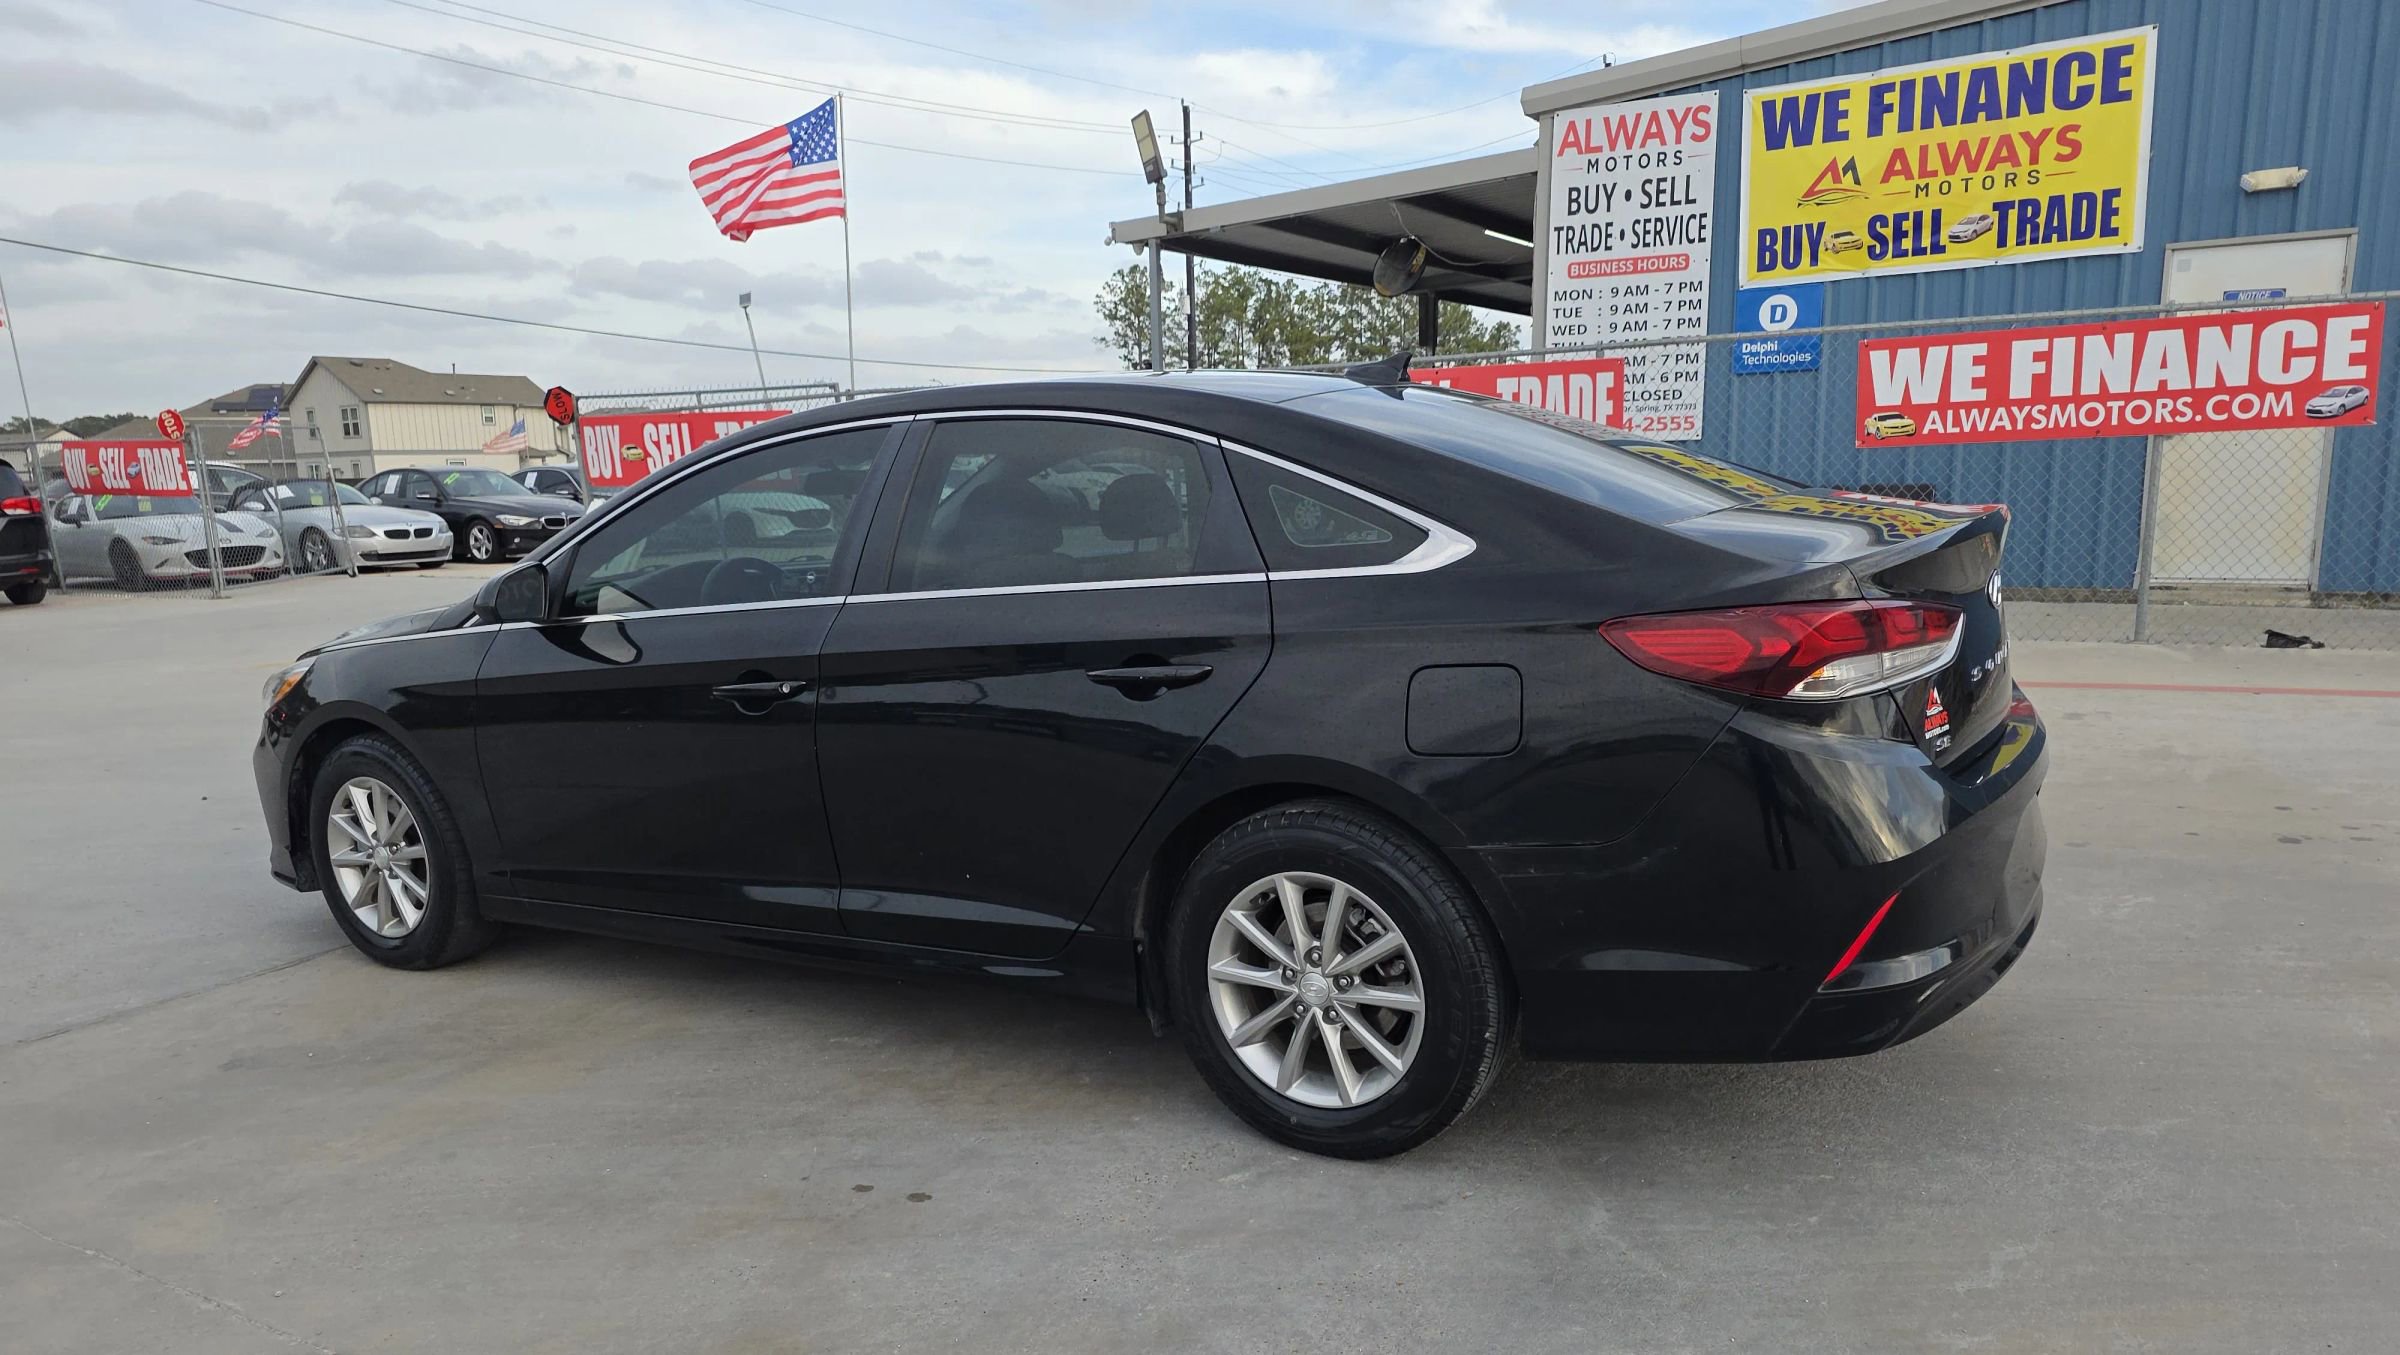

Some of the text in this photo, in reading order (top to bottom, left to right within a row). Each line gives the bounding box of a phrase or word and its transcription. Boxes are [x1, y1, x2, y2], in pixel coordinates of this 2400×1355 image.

[1761, 44, 2135, 151] WE FINANCE
[1557, 105, 1711, 157] ALWAYS
[1587, 150, 1683, 174] MOTORS
[1880, 124, 2082, 185] ALWAYS
[1567, 175, 1697, 216] BUY SELL
[1914, 169, 2041, 198] MOTORS
[1554, 213, 1708, 255] TRADE SERVICE
[1757, 187, 2122, 273] BUY SELL TRADE
[1570, 255, 1687, 278] BUSINESS HOURS
[1554, 289, 1593, 302] MON
[1610, 287, 1620, 298] 9
[1623, 284, 1650, 297] AM
[1664, 283, 1674, 295] 7
[1678, 280, 1704, 293] PM
[2238, 290, 2272, 301] NOTICE
[1553, 307, 1583, 319] TUE
[1609, 304, 1619, 315] 9
[1622, 302, 1649, 315] AM
[1663, 300, 1673, 312] 7
[1677, 299, 1702, 311] PM
[1770, 304, 1788, 324] D
[1552, 324, 1588, 337] WED
[1609, 322, 1618, 333] 9
[1622, 320, 1648, 333] AM
[1662, 319, 1672, 330] 7
[1677, 317, 1701, 329] PM
[1624, 355, 1646, 367] AM
[1661, 354, 1670, 366] 7
[1675, 353, 1700, 365] PM
[1742, 341, 1778, 353] Delphi
[1742, 352, 1812, 365] Technologies
[1869, 314, 2371, 407] WE FINANCE
[1623, 373, 1645, 385] AM
[1660, 372, 1669, 383] 6
[1674, 371, 1699, 382] PM
[551, 392, 571, 421] SLOW
[1497, 371, 1615, 426] TRADE
[1624, 389, 1683, 402] CLOSED
[1635, 405, 1661, 413] Spring,
[1663, 404, 1674, 412] TX
[1675, 403, 1697, 411] 77373
[161, 411, 181, 440] STOP
[1921, 391, 2294, 435] ALWAYSMOTORS.COM
[583, 422, 692, 479] BUY SELL
[63, 447, 188, 490] BUY SELL TRADE
